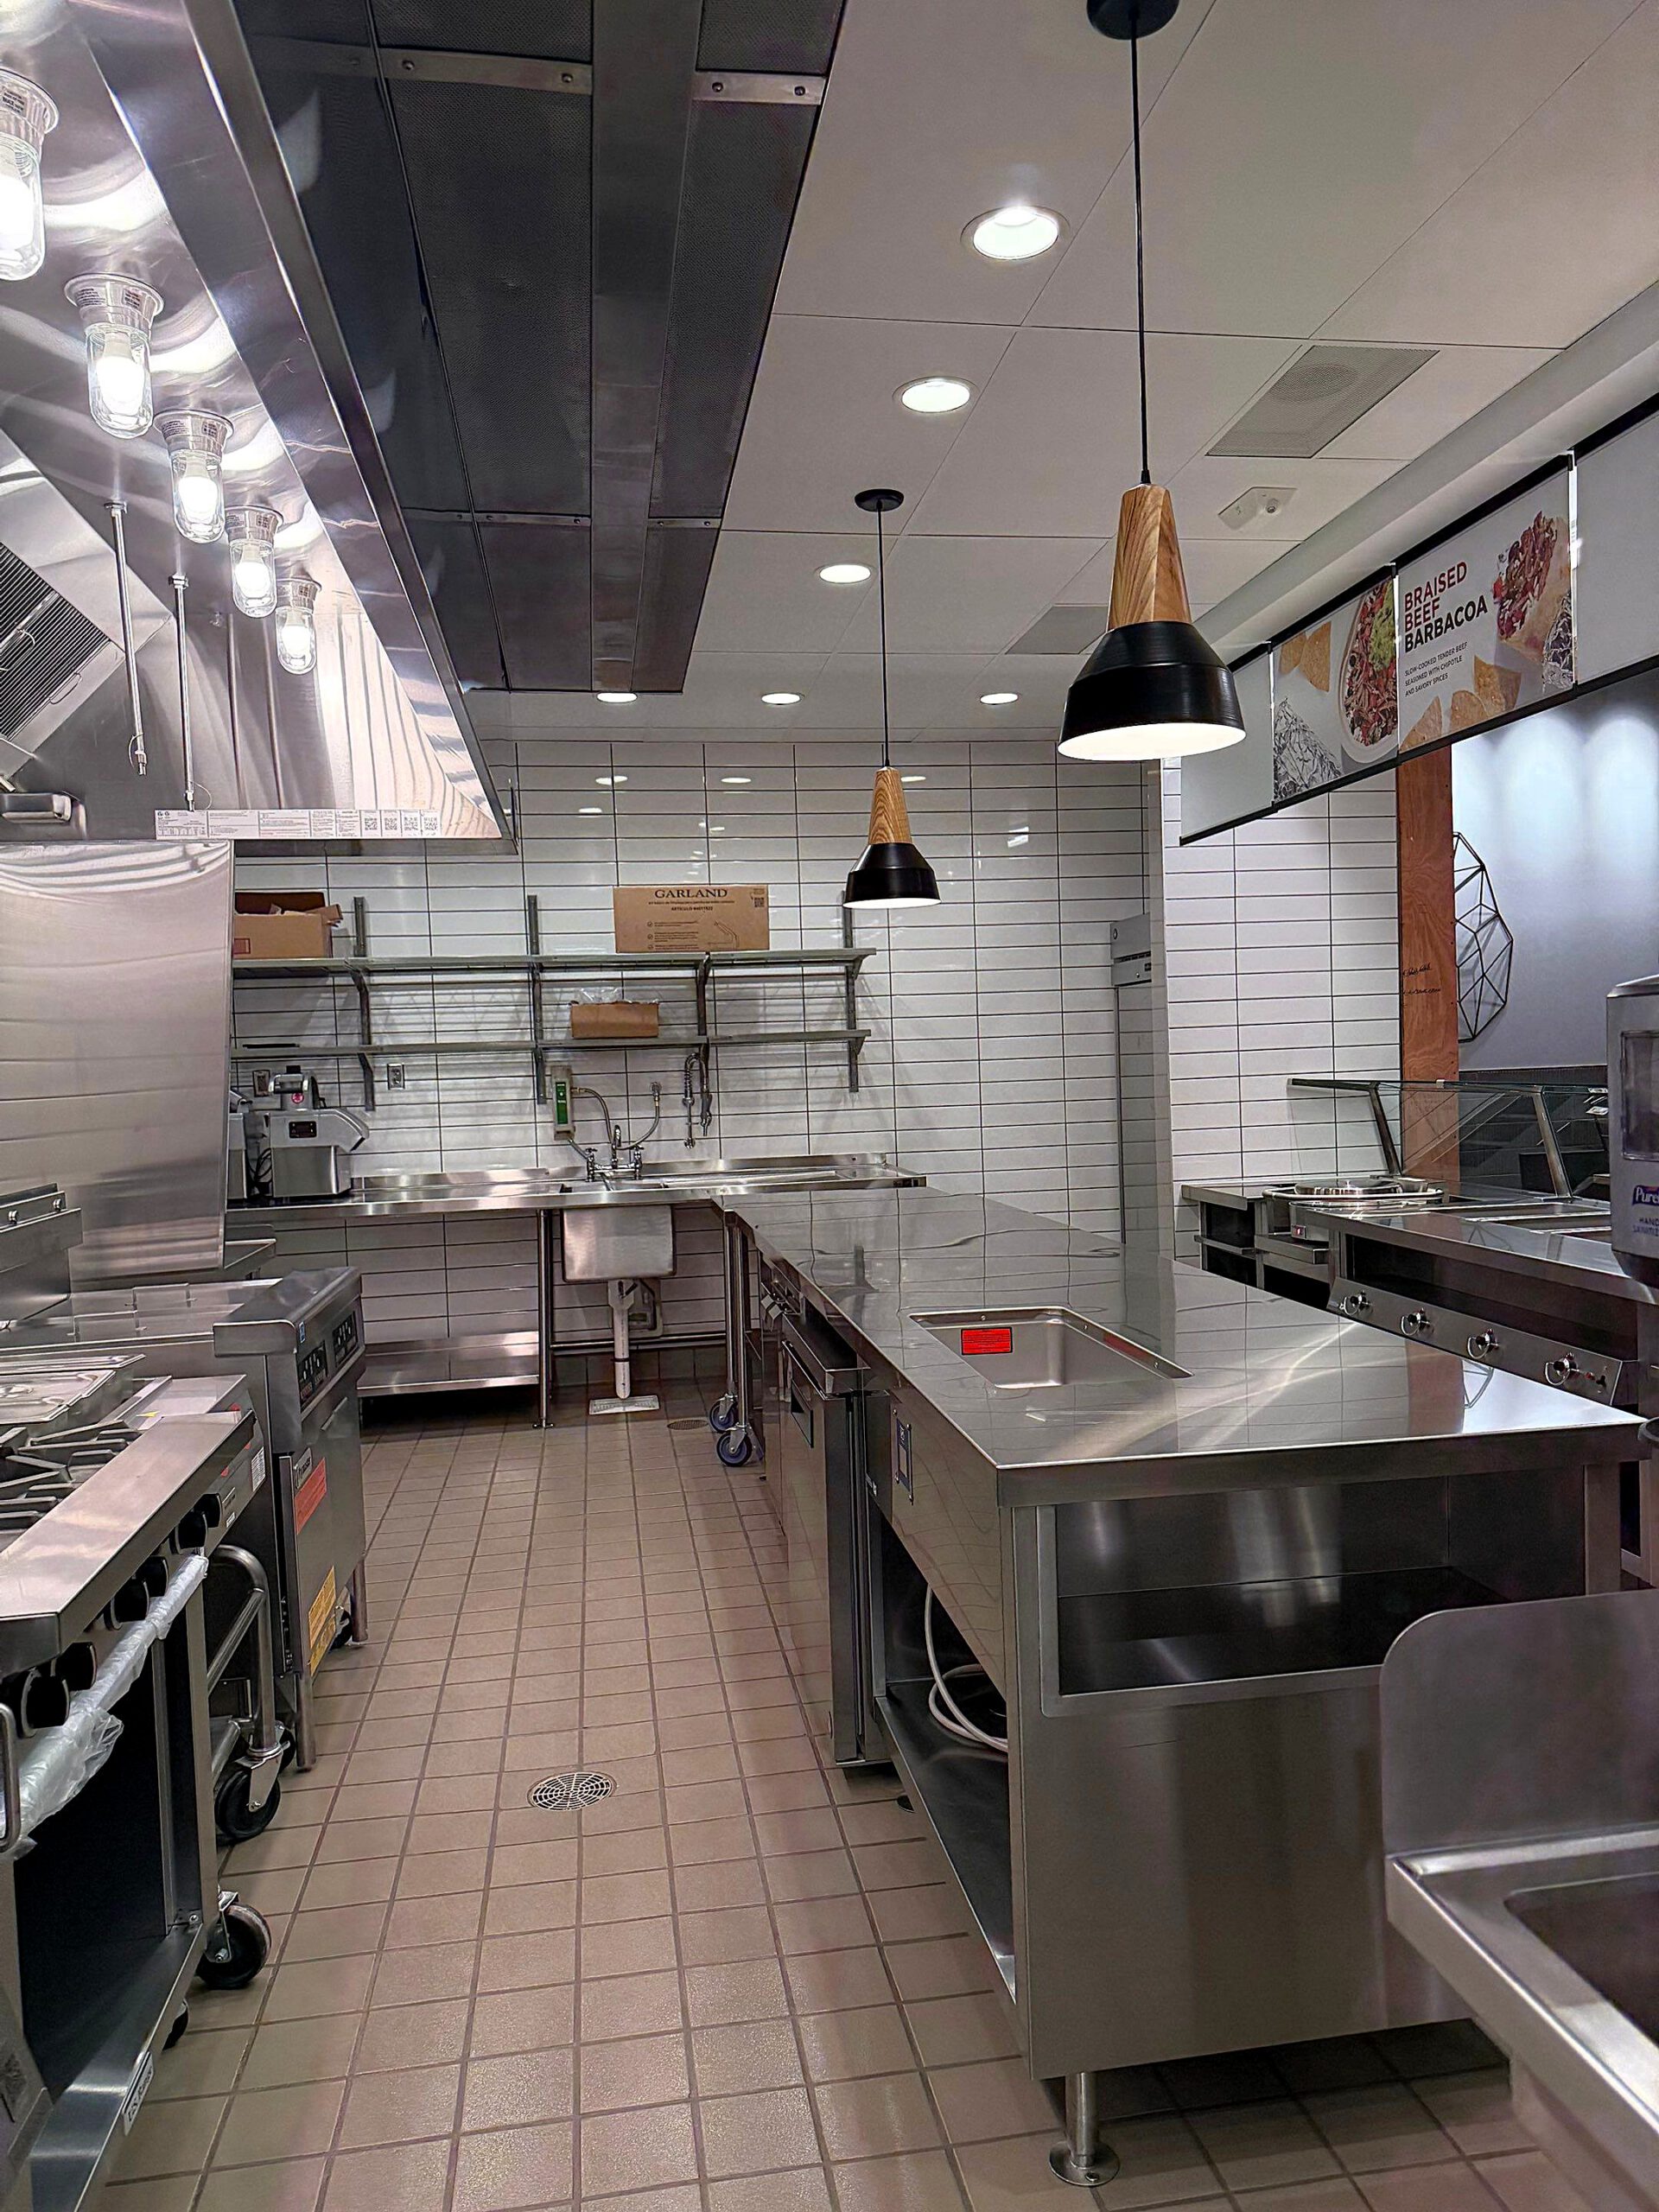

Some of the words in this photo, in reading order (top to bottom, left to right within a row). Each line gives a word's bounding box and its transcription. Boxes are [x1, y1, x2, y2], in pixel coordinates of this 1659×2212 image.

[1404, 561, 1467, 613] BRAISED
[1404, 596, 1440, 633] BEEF
[1404, 594, 1488, 653] BARBACOA
[1405, 657, 1437, 677] SLOW-COOKED
[1437, 647, 1455, 661] TENDER
[1455, 641, 1468, 653] BEEF
[1405, 671, 1428, 687] SEASONED
[1428, 665, 1440, 676] WITH
[1440, 655, 1463, 671] CHIPOTLE
[1405, 687, 1415, 698] AND
[1414, 679, 1433, 693] SAVORY
[1433, 672, 1448, 684] SPICES
[654, 888, 728, 899] GARLAND
